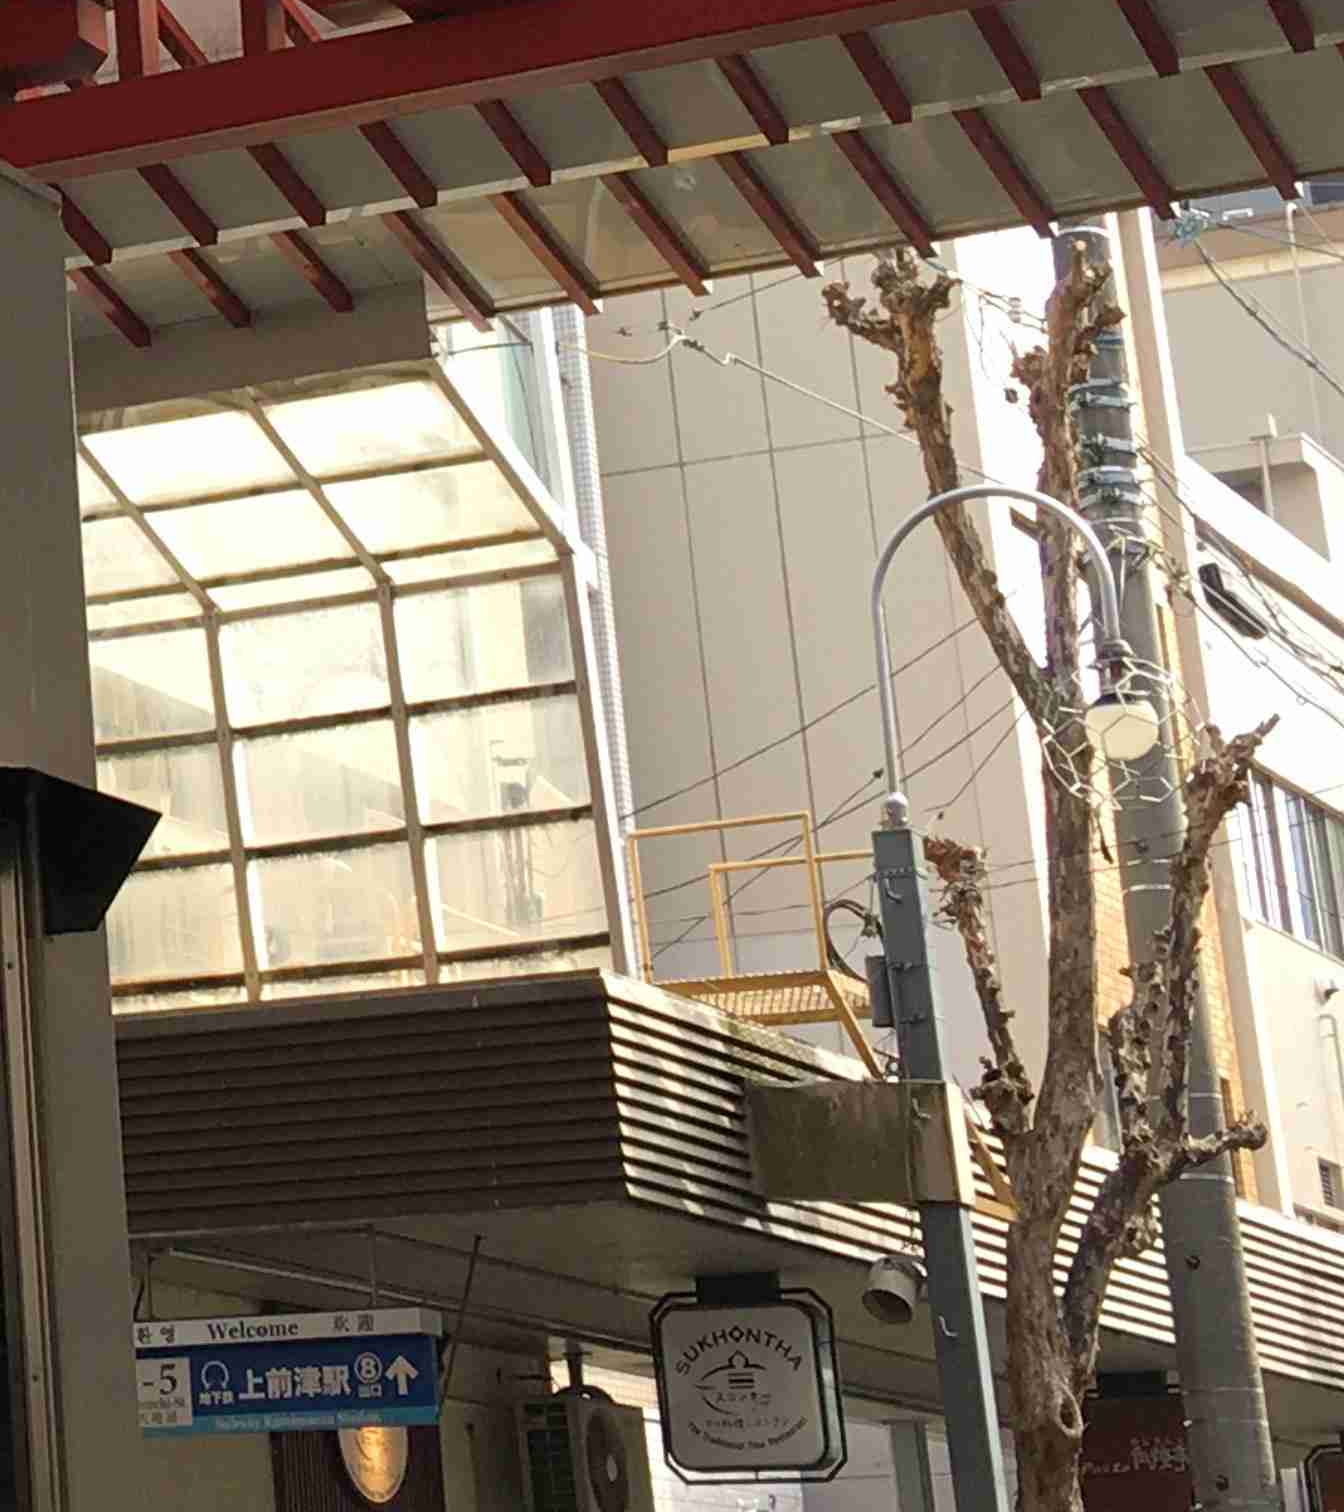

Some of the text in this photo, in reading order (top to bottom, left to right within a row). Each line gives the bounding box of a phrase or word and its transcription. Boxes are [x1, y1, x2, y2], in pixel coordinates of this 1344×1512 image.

[208, 1320, 299, 1340] Welcome
[675, 1325, 803, 1377] SUKHONTHA
[239, 1364, 352, 1399] 上前津駅
